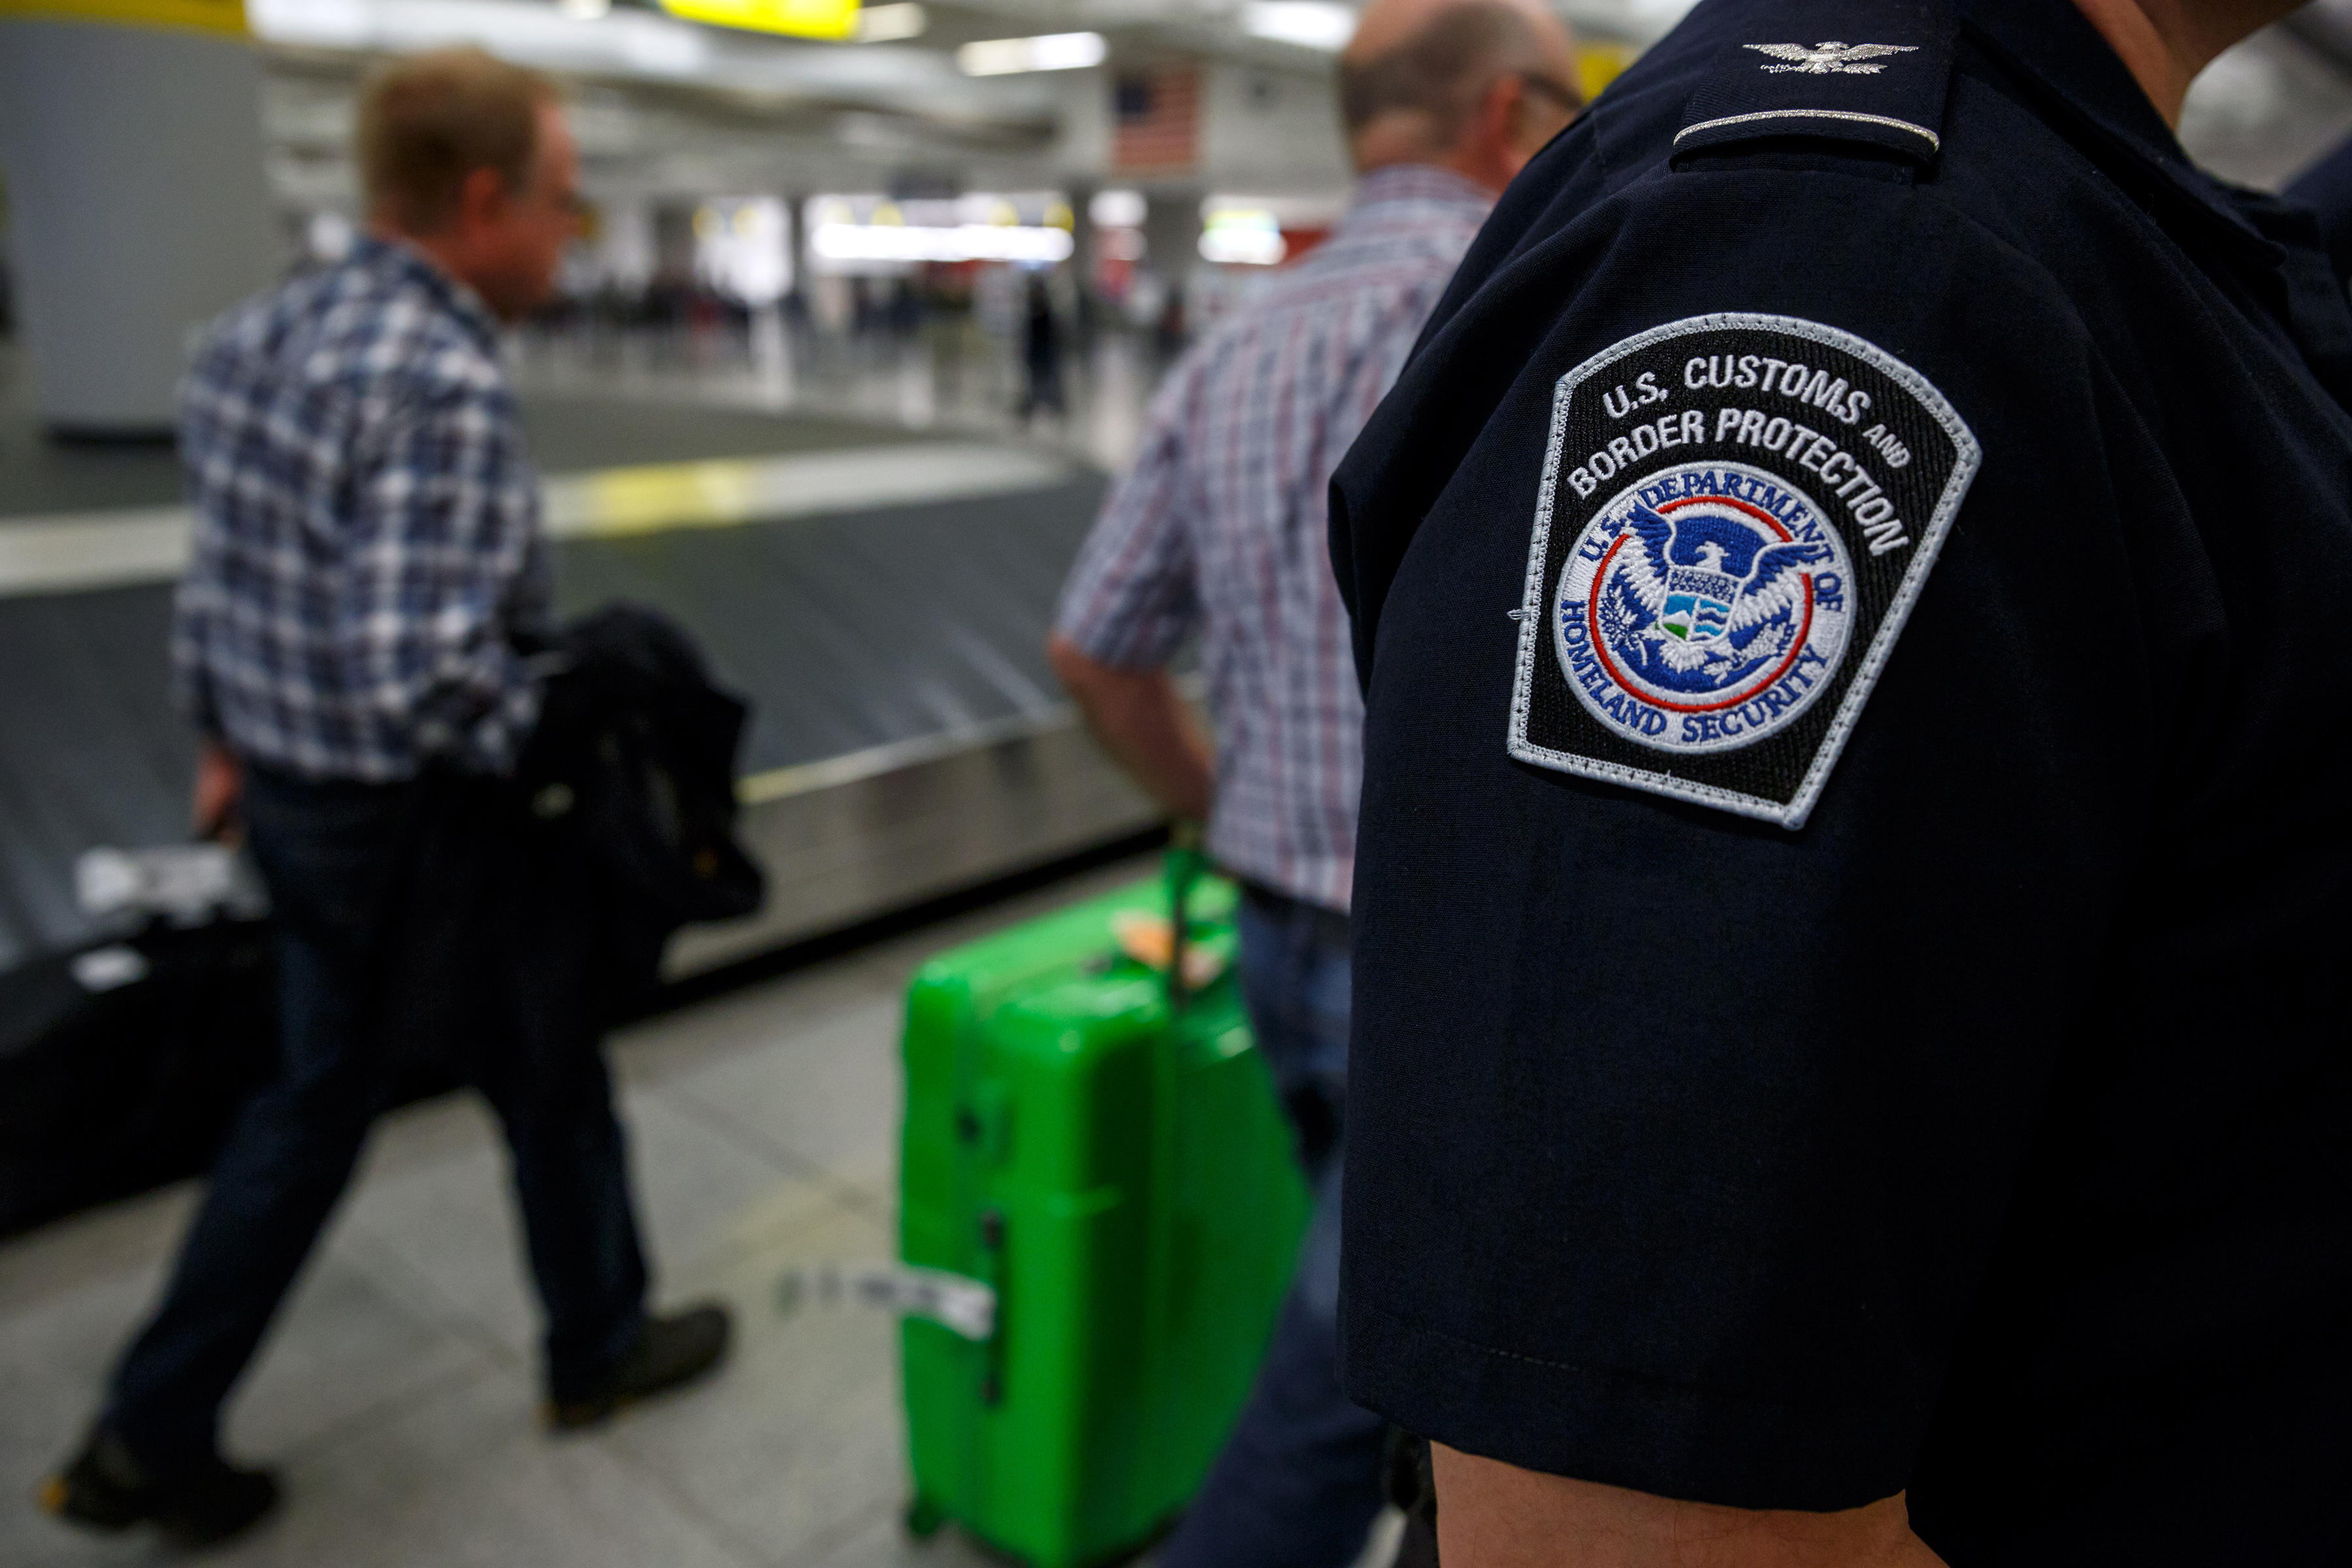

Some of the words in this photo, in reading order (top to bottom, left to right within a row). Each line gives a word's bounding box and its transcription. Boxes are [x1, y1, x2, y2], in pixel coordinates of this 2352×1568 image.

[1567, 410, 1705, 499] BORDER
[1715, 408, 1909, 557] PROTECTION
[1603, 372, 1668, 418] U.S.
[1684, 355, 1872, 424] CUSTOMS
[1862, 424, 1911, 468] AND
[1639, 470, 1835, 564] DEPARTMENT
[1814, 572, 1844, 612] OF
[1561, 600, 1666, 735] HOMELAND
[1682, 643, 1827, 742] SECURITY
